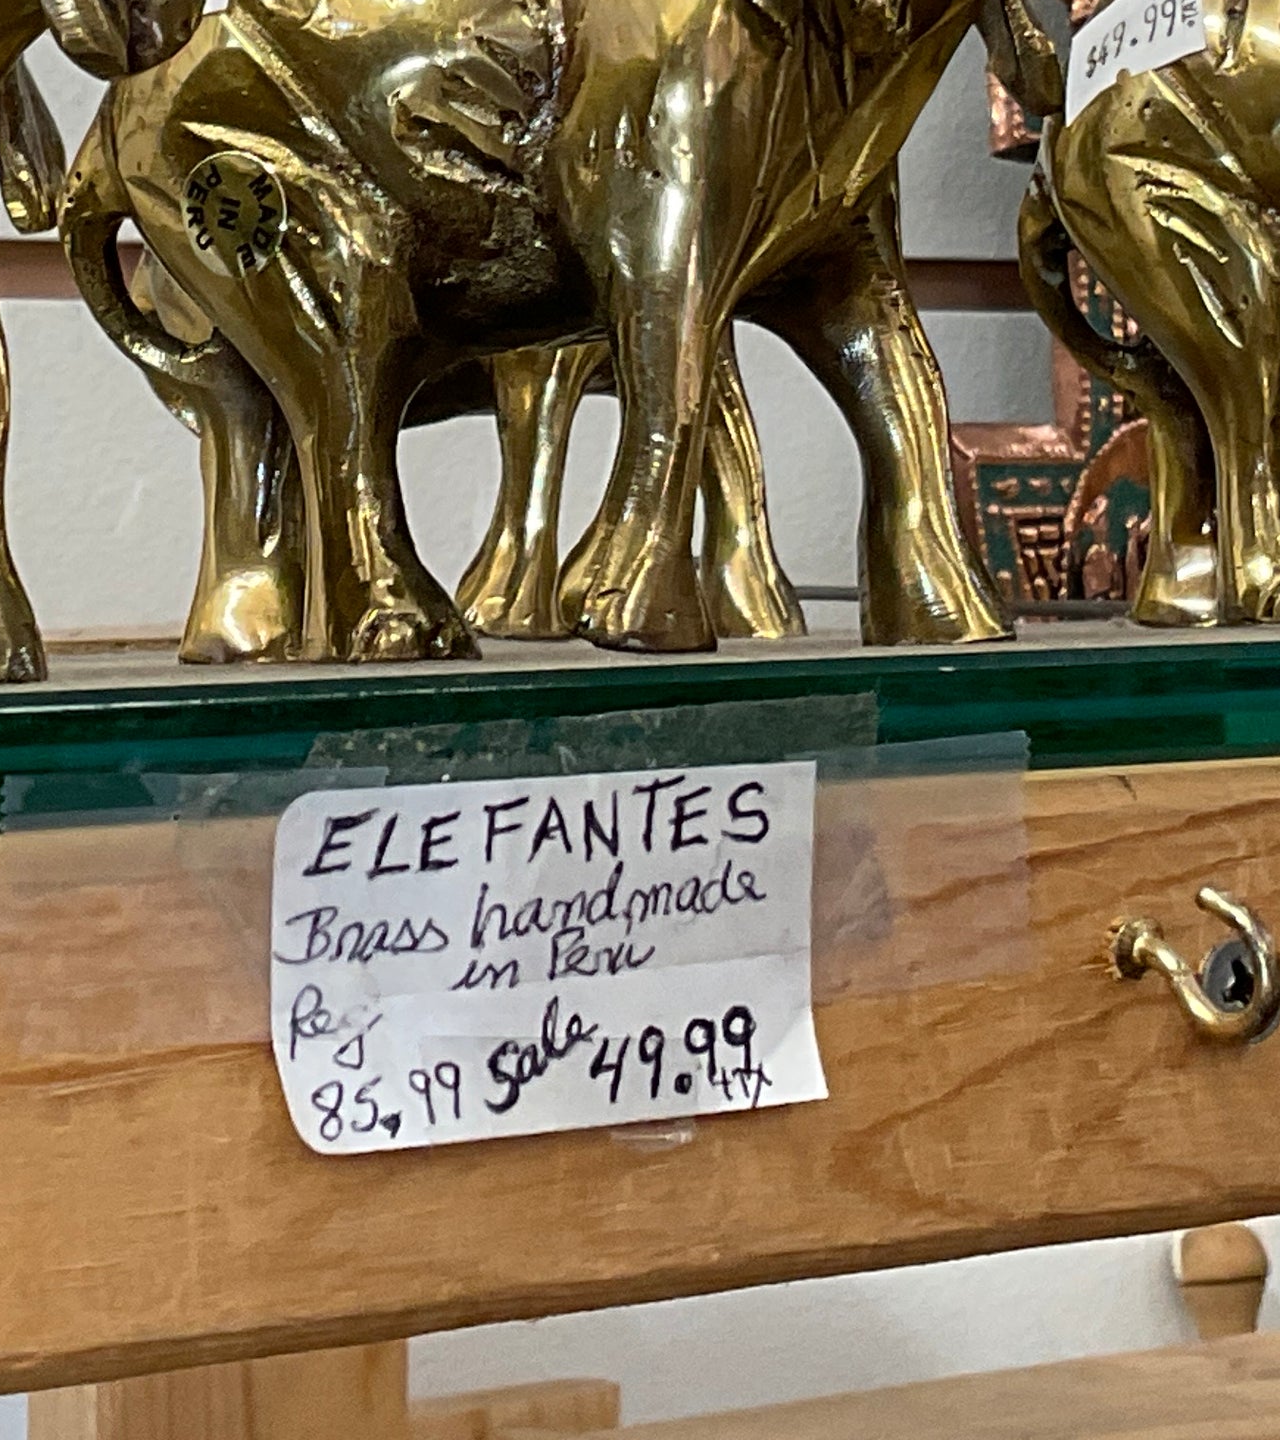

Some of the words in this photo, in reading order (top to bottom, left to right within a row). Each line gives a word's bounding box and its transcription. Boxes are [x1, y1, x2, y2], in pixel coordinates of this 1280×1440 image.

[185, 162, 224, 251] PERU
[217, 196, 242, 231] IN
[235, 171, 278, 270] MADE
[303, 775, 770, 878] ELEFANTES
[274, 906, 448, 965] Brass
[450, 955, 519, 991] in
[546, 928, 657, 982] Peru
[288, 985, 384, 1068] Reg
[590, 1005, 756, 1108] 49.99
